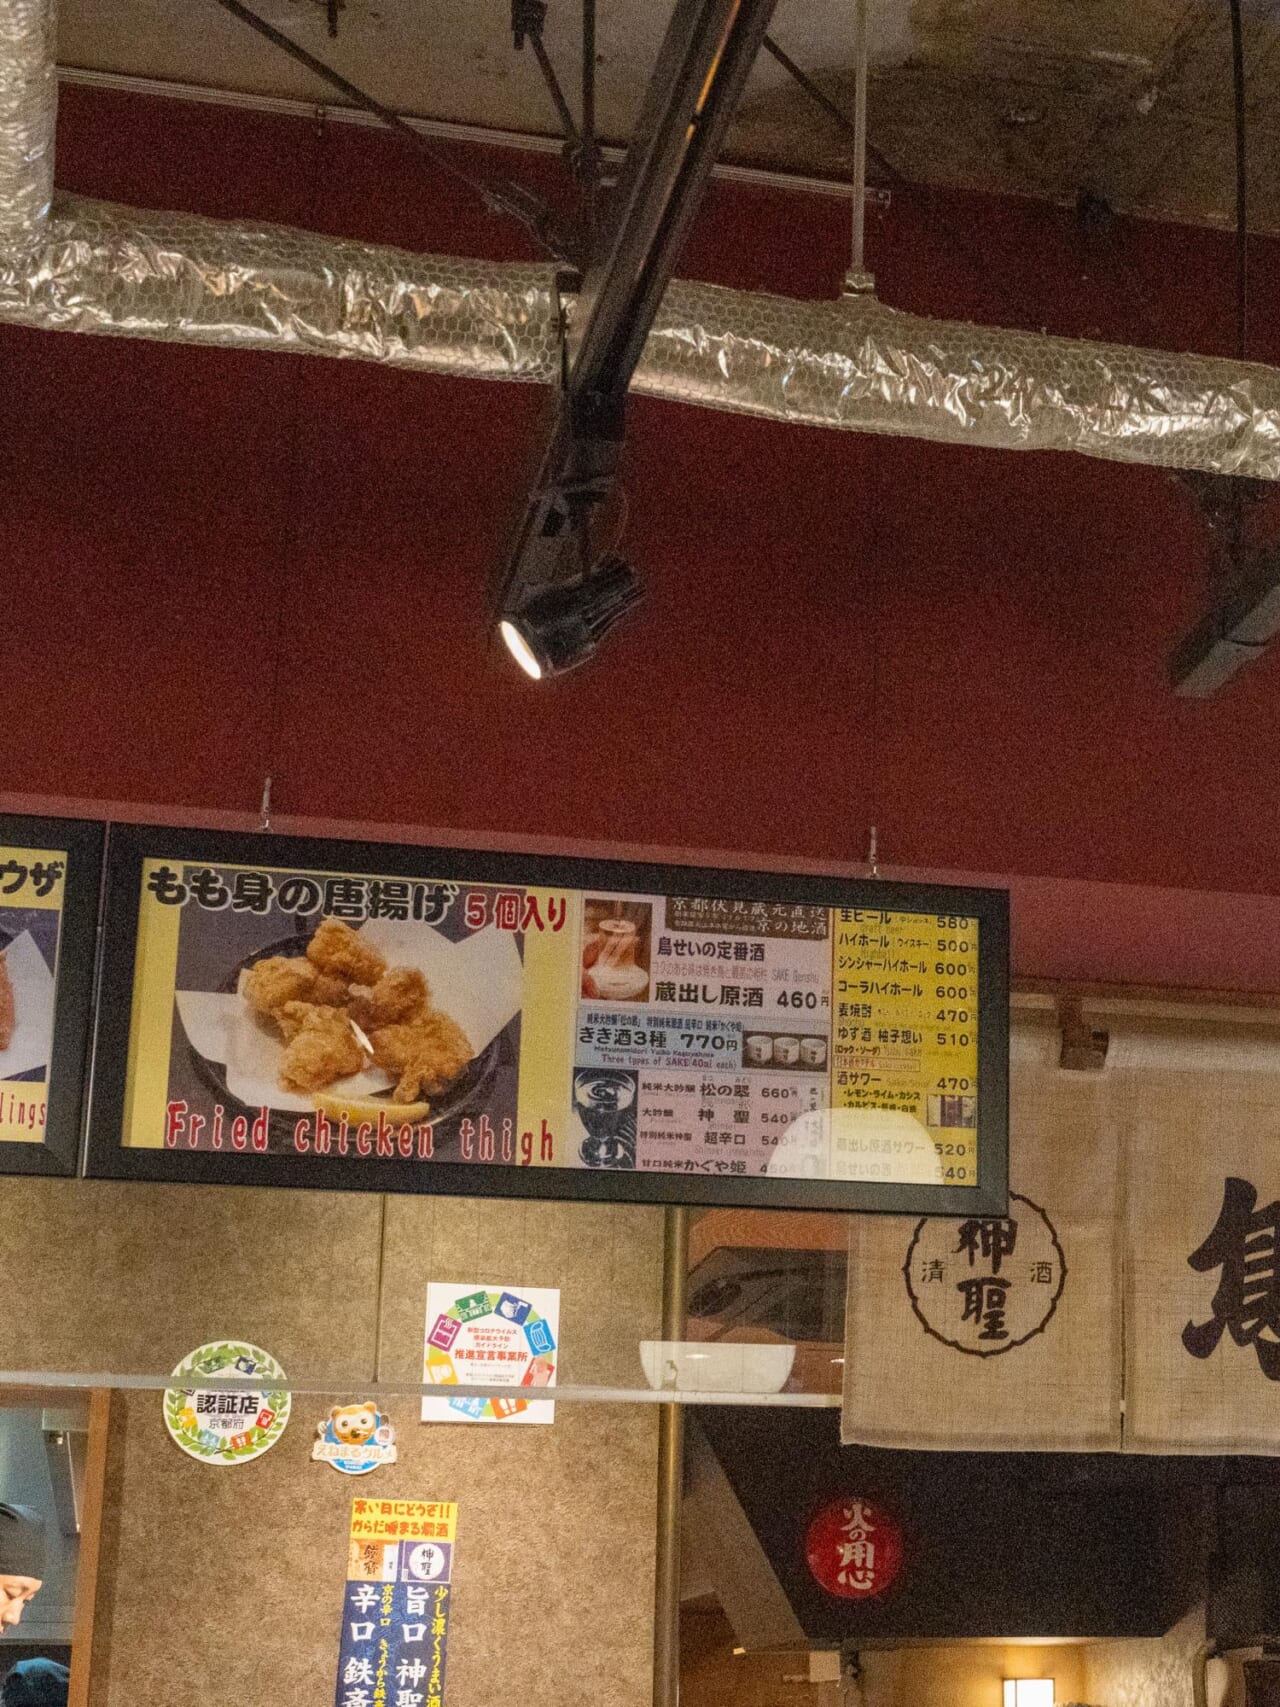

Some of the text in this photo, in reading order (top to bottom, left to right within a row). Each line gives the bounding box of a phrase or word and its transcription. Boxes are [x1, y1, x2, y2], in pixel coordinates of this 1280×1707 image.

[147, 866, 567, 932] もも身の唐揚げ 5個入り
[657, 936, 765, 962] 鳥せいの定番酒
[655, 981, 764, 1008] 蔵出し原酒
[602, 1054, 625, 1064] Three
[628, 1056, 649, 1067] types
[167, 1100, 553, 1166] Fried chicken thigh
[704, 1132, 746, 1145] 超辛口
[454, 1349, 528, 1363] 推進宣言事業所
[197, 1395, 259, 1415] 認証店
[208, 1417, 244, 1430] 京都府
[837, 1502, 876, 1590] 火の用心
[350, 1584, 380, 1643] 辛口
[402, 1586, 430, 1643] 旨口
